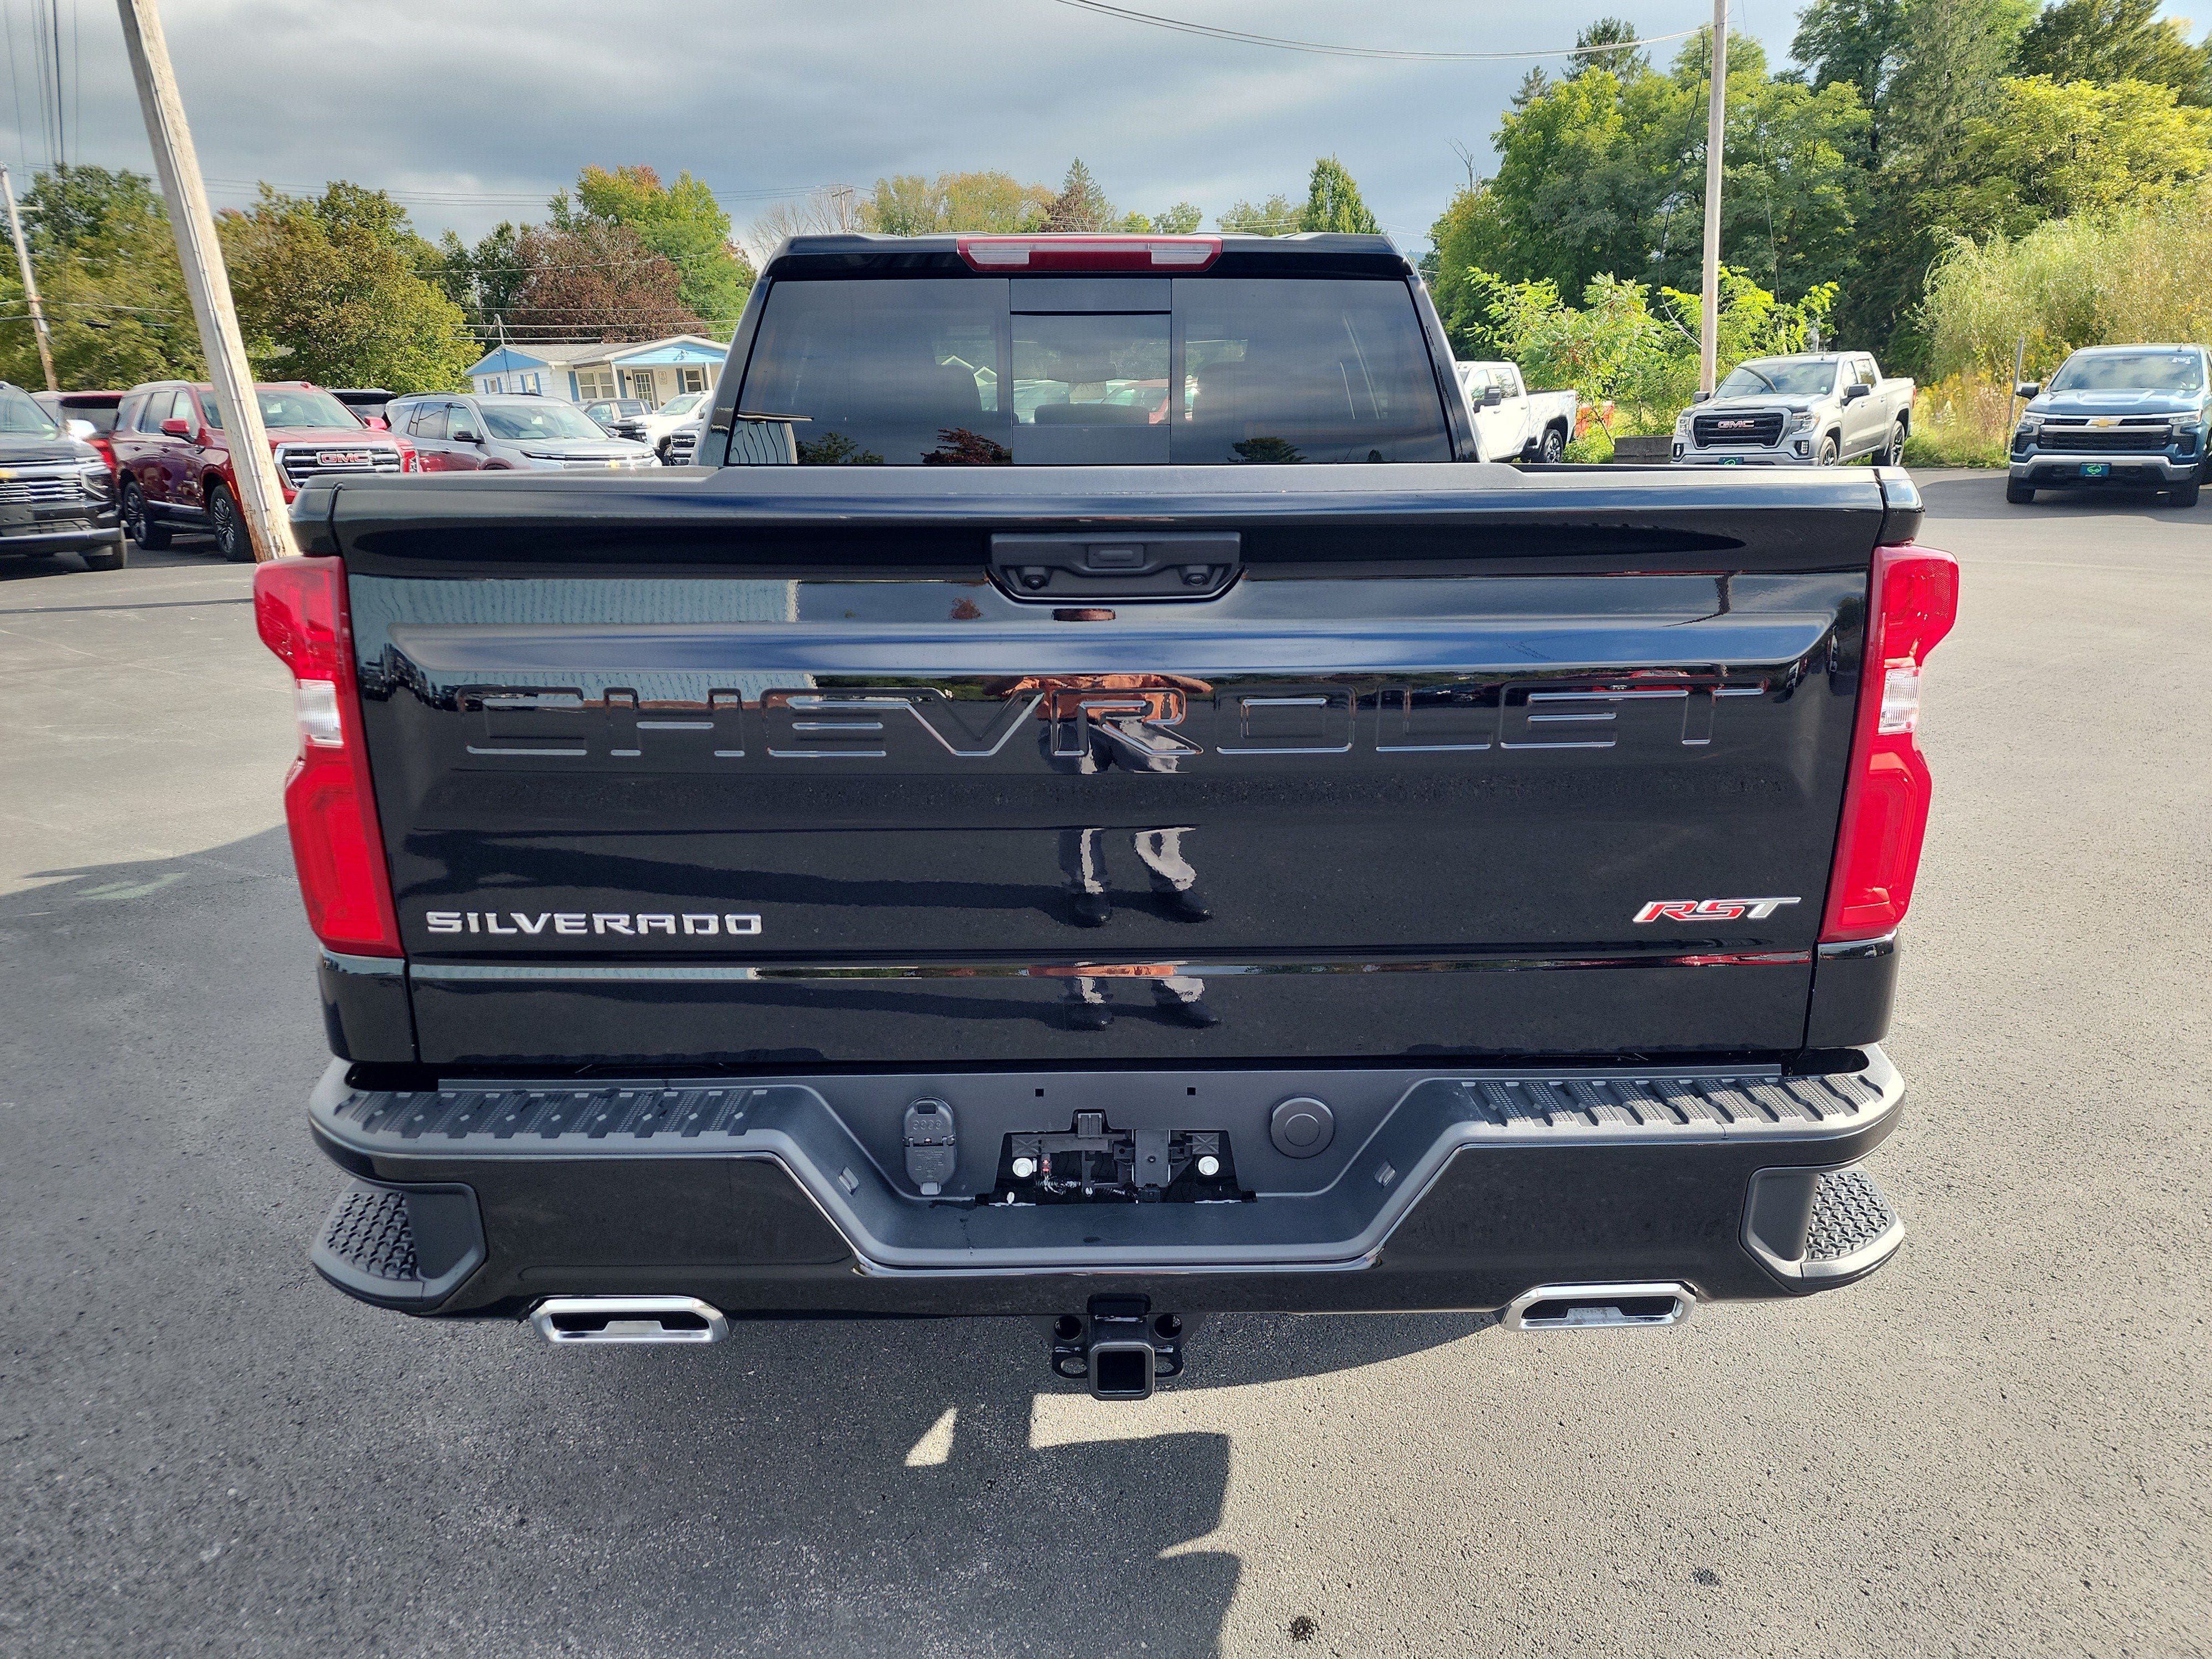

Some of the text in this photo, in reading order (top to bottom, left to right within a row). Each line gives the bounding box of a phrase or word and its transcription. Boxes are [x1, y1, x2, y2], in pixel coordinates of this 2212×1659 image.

[1718, 420, 1754, 429] GMC
[321, 453, 369, 463] GMC
[455, 676, 1768, 759] CHEVROLET
[1632, 896, 1802, 923] RST
[426, 911, 762, 935] SILVERADO
